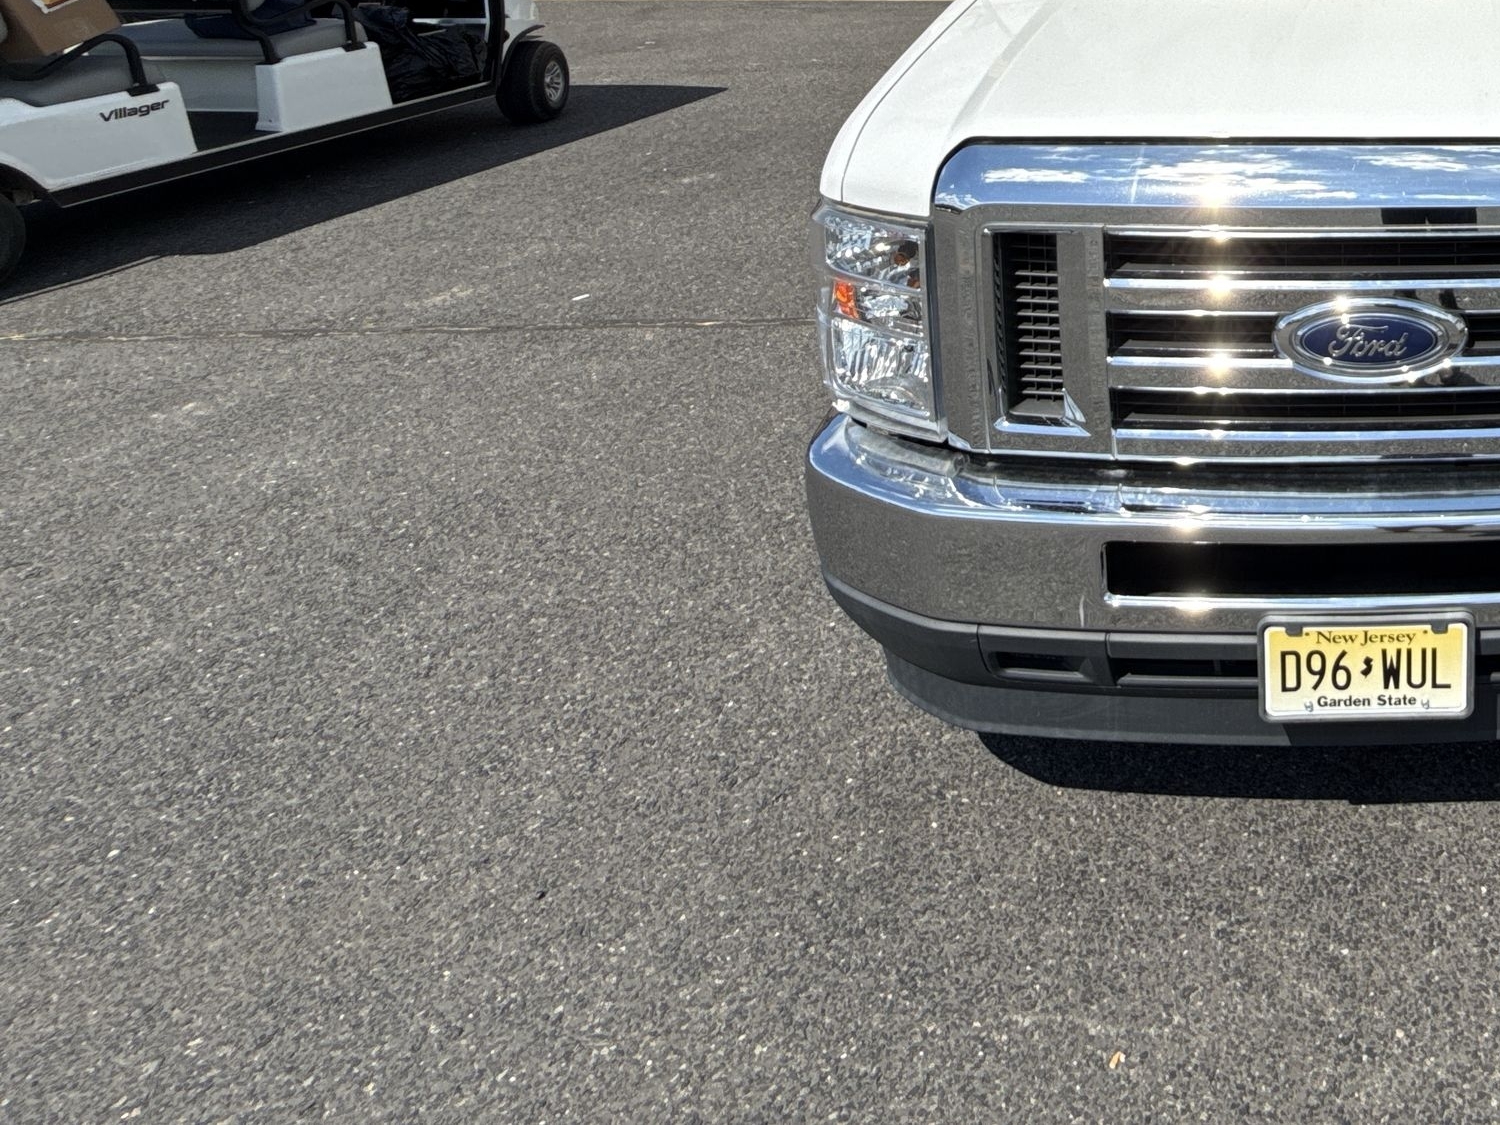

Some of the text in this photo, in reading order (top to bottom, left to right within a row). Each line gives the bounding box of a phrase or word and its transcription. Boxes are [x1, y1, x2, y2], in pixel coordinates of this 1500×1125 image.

[99, 99, 170, 122] Villager
[1327, 324, 1409, 358] Ford
[1315, 630, 1417, 647] New Jersey
[1279, 647, 1452, 693] D96 WUL
[1317, 694, 1417, 708] Garden State
